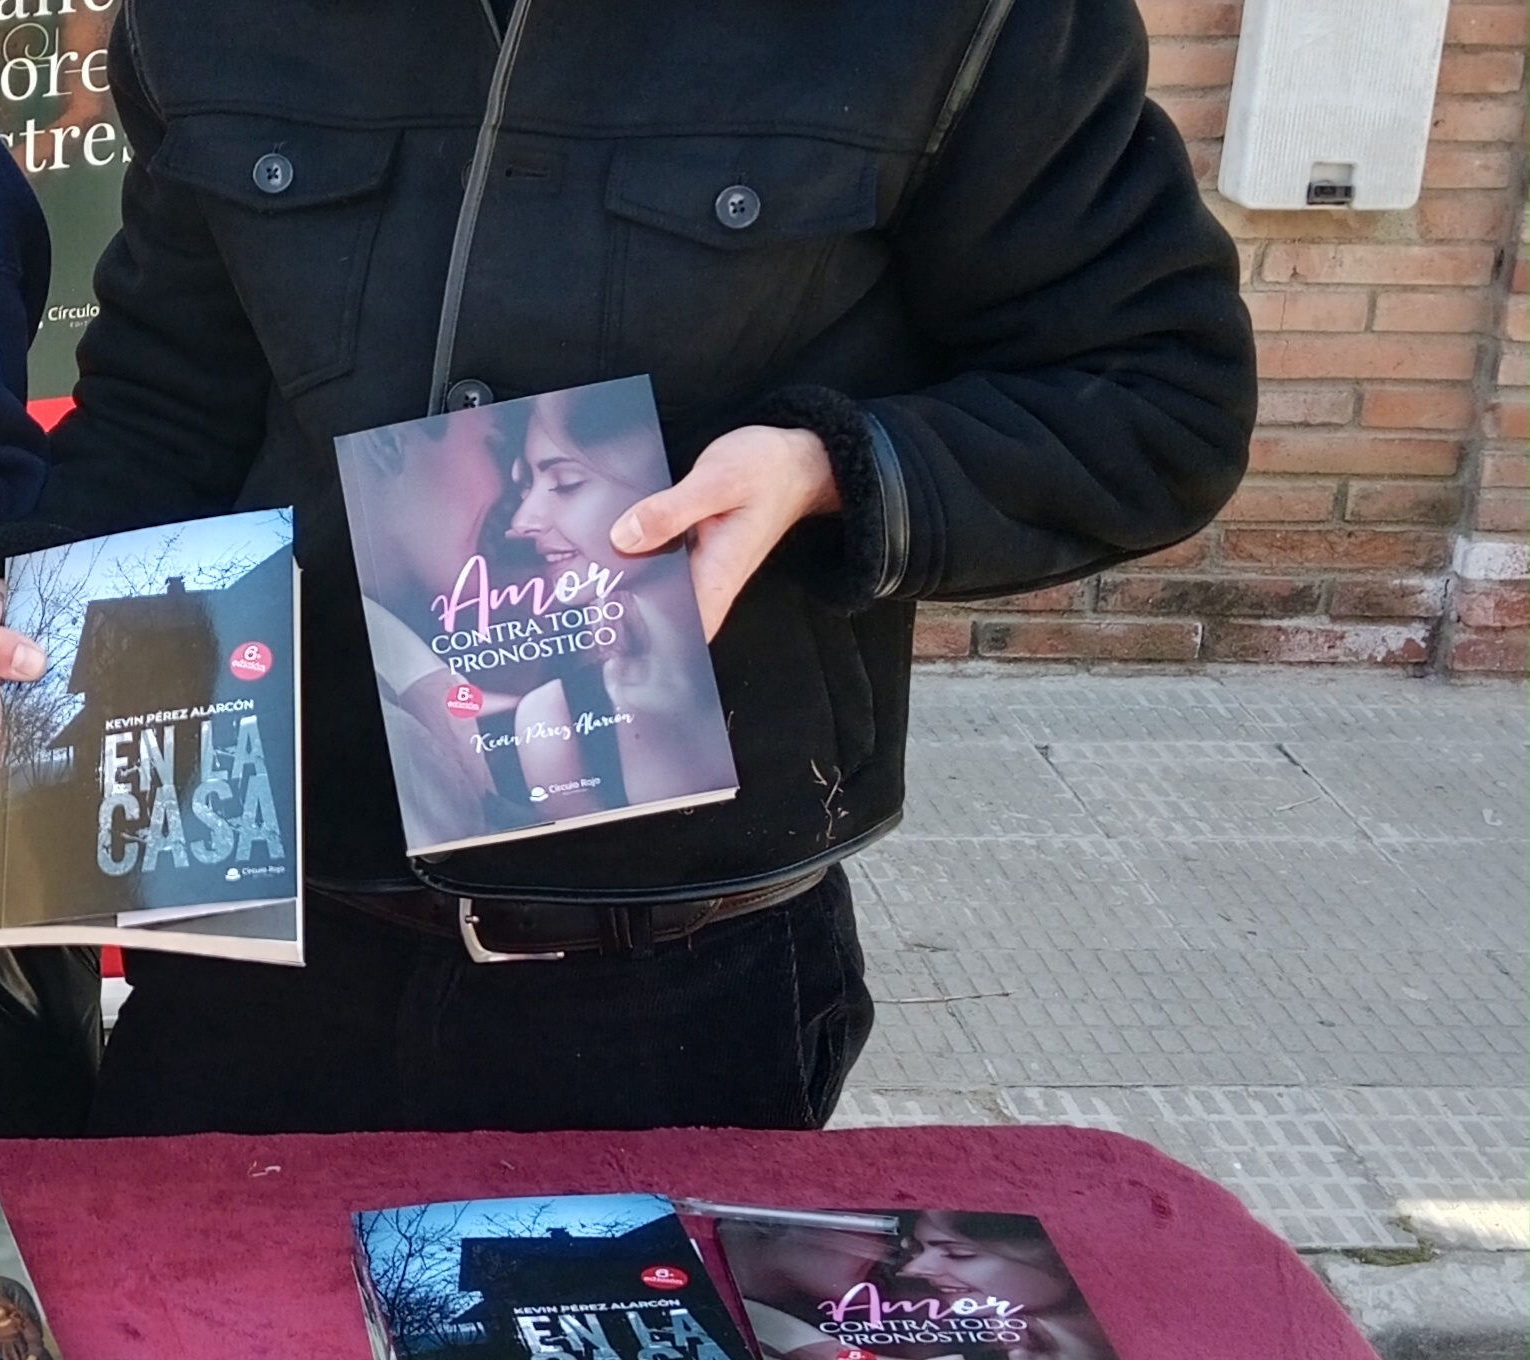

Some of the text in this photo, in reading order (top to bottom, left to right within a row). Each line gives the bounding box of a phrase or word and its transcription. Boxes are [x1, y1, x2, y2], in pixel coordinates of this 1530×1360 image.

[48, 303, 100, 321] Círculo
[431, 555, 623, 643] Amor
[431, 600, 624, 656] CONTRA TODO
[448, 626, 617, 675] PRONÓSTICO
[105, 698, 254, 730] KEVIN PÉREZ ALARCÓN
[100, 714, 267, 797] EN LA
[470, 731, 521, 754] Kevin
[96, 775, 286, 877] CASA
[513, 1299, 680, 1316] KEVIN PÉREZ ALARCÓN
[817, 1282, 1023, 1330] Amor
[819, 1317, 1027, 1334] CONTRA TODO
[516, 1309, 709, 1353] EN LA
[837, 1328, 1021, 1345] PRONÓSTICO
